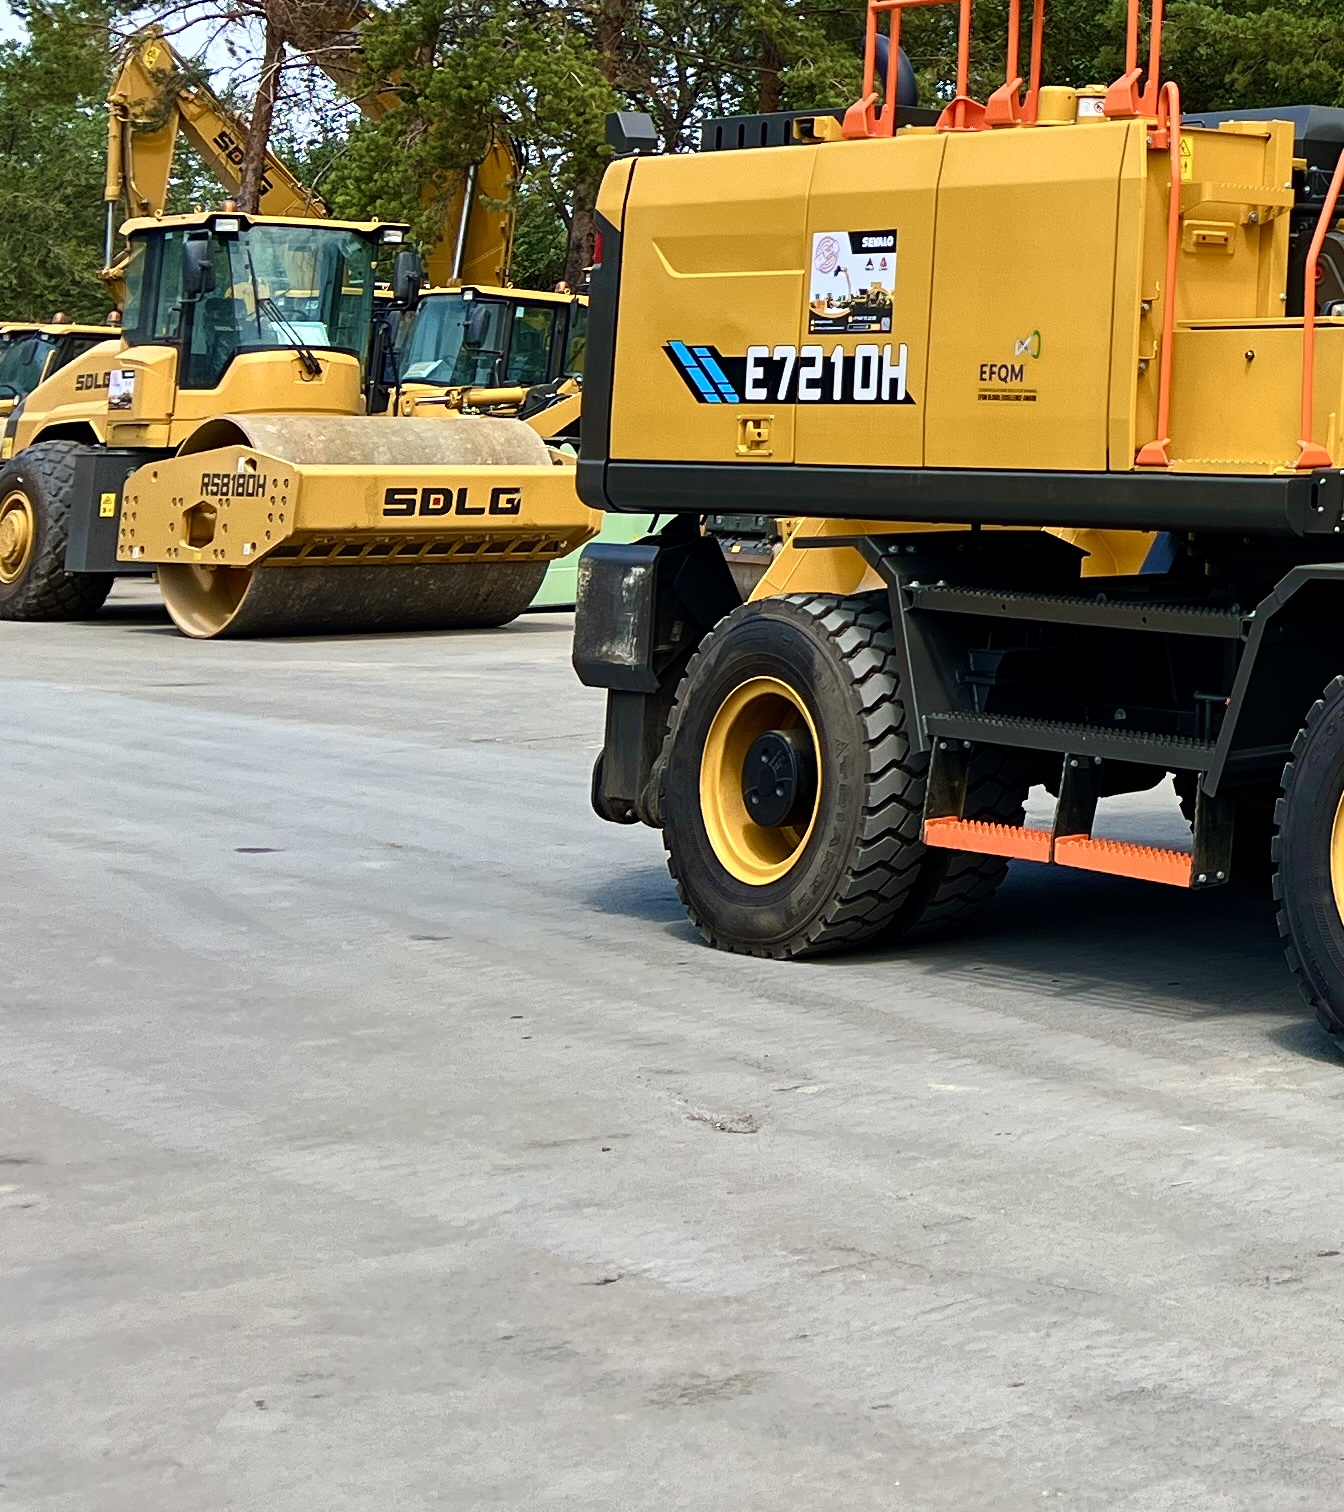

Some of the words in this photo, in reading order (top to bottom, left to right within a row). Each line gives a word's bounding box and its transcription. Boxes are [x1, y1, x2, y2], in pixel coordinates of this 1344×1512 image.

[745, 343, 908, 400] E7210H
[979, 363, 1024, 384] EFQM
[200, 473, 266, 498] RS8180H
[383, 487, 521, 516] SDLG
